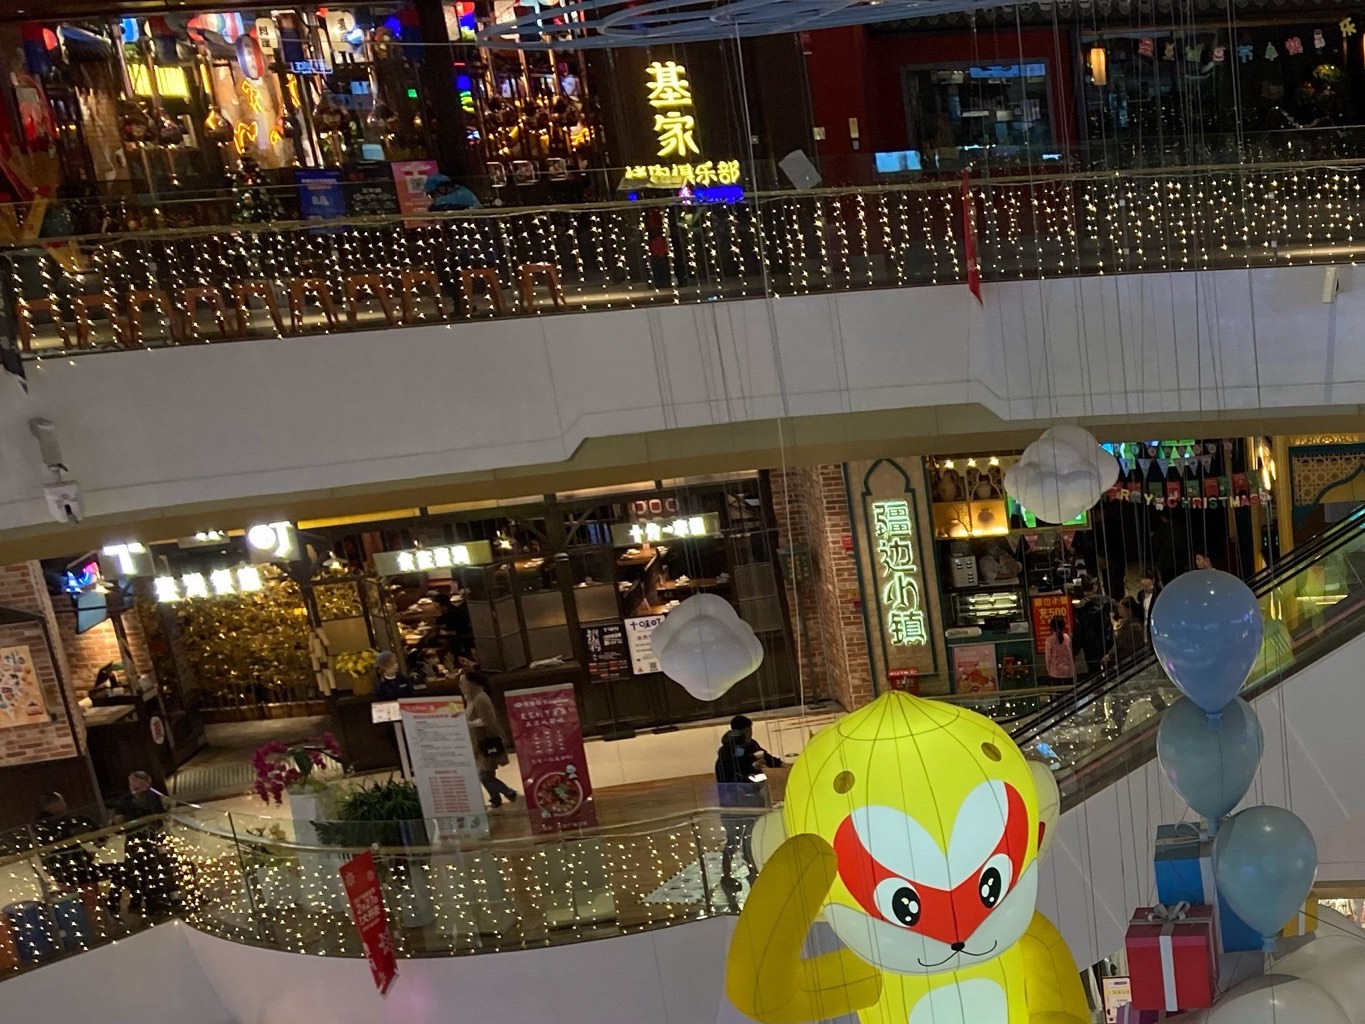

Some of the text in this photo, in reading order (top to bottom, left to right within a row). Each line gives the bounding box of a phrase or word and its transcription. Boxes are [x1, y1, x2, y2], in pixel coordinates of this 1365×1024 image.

[645, 60, 700, 157] 基家
[872, 501, 927, 646] 疆边小镇
